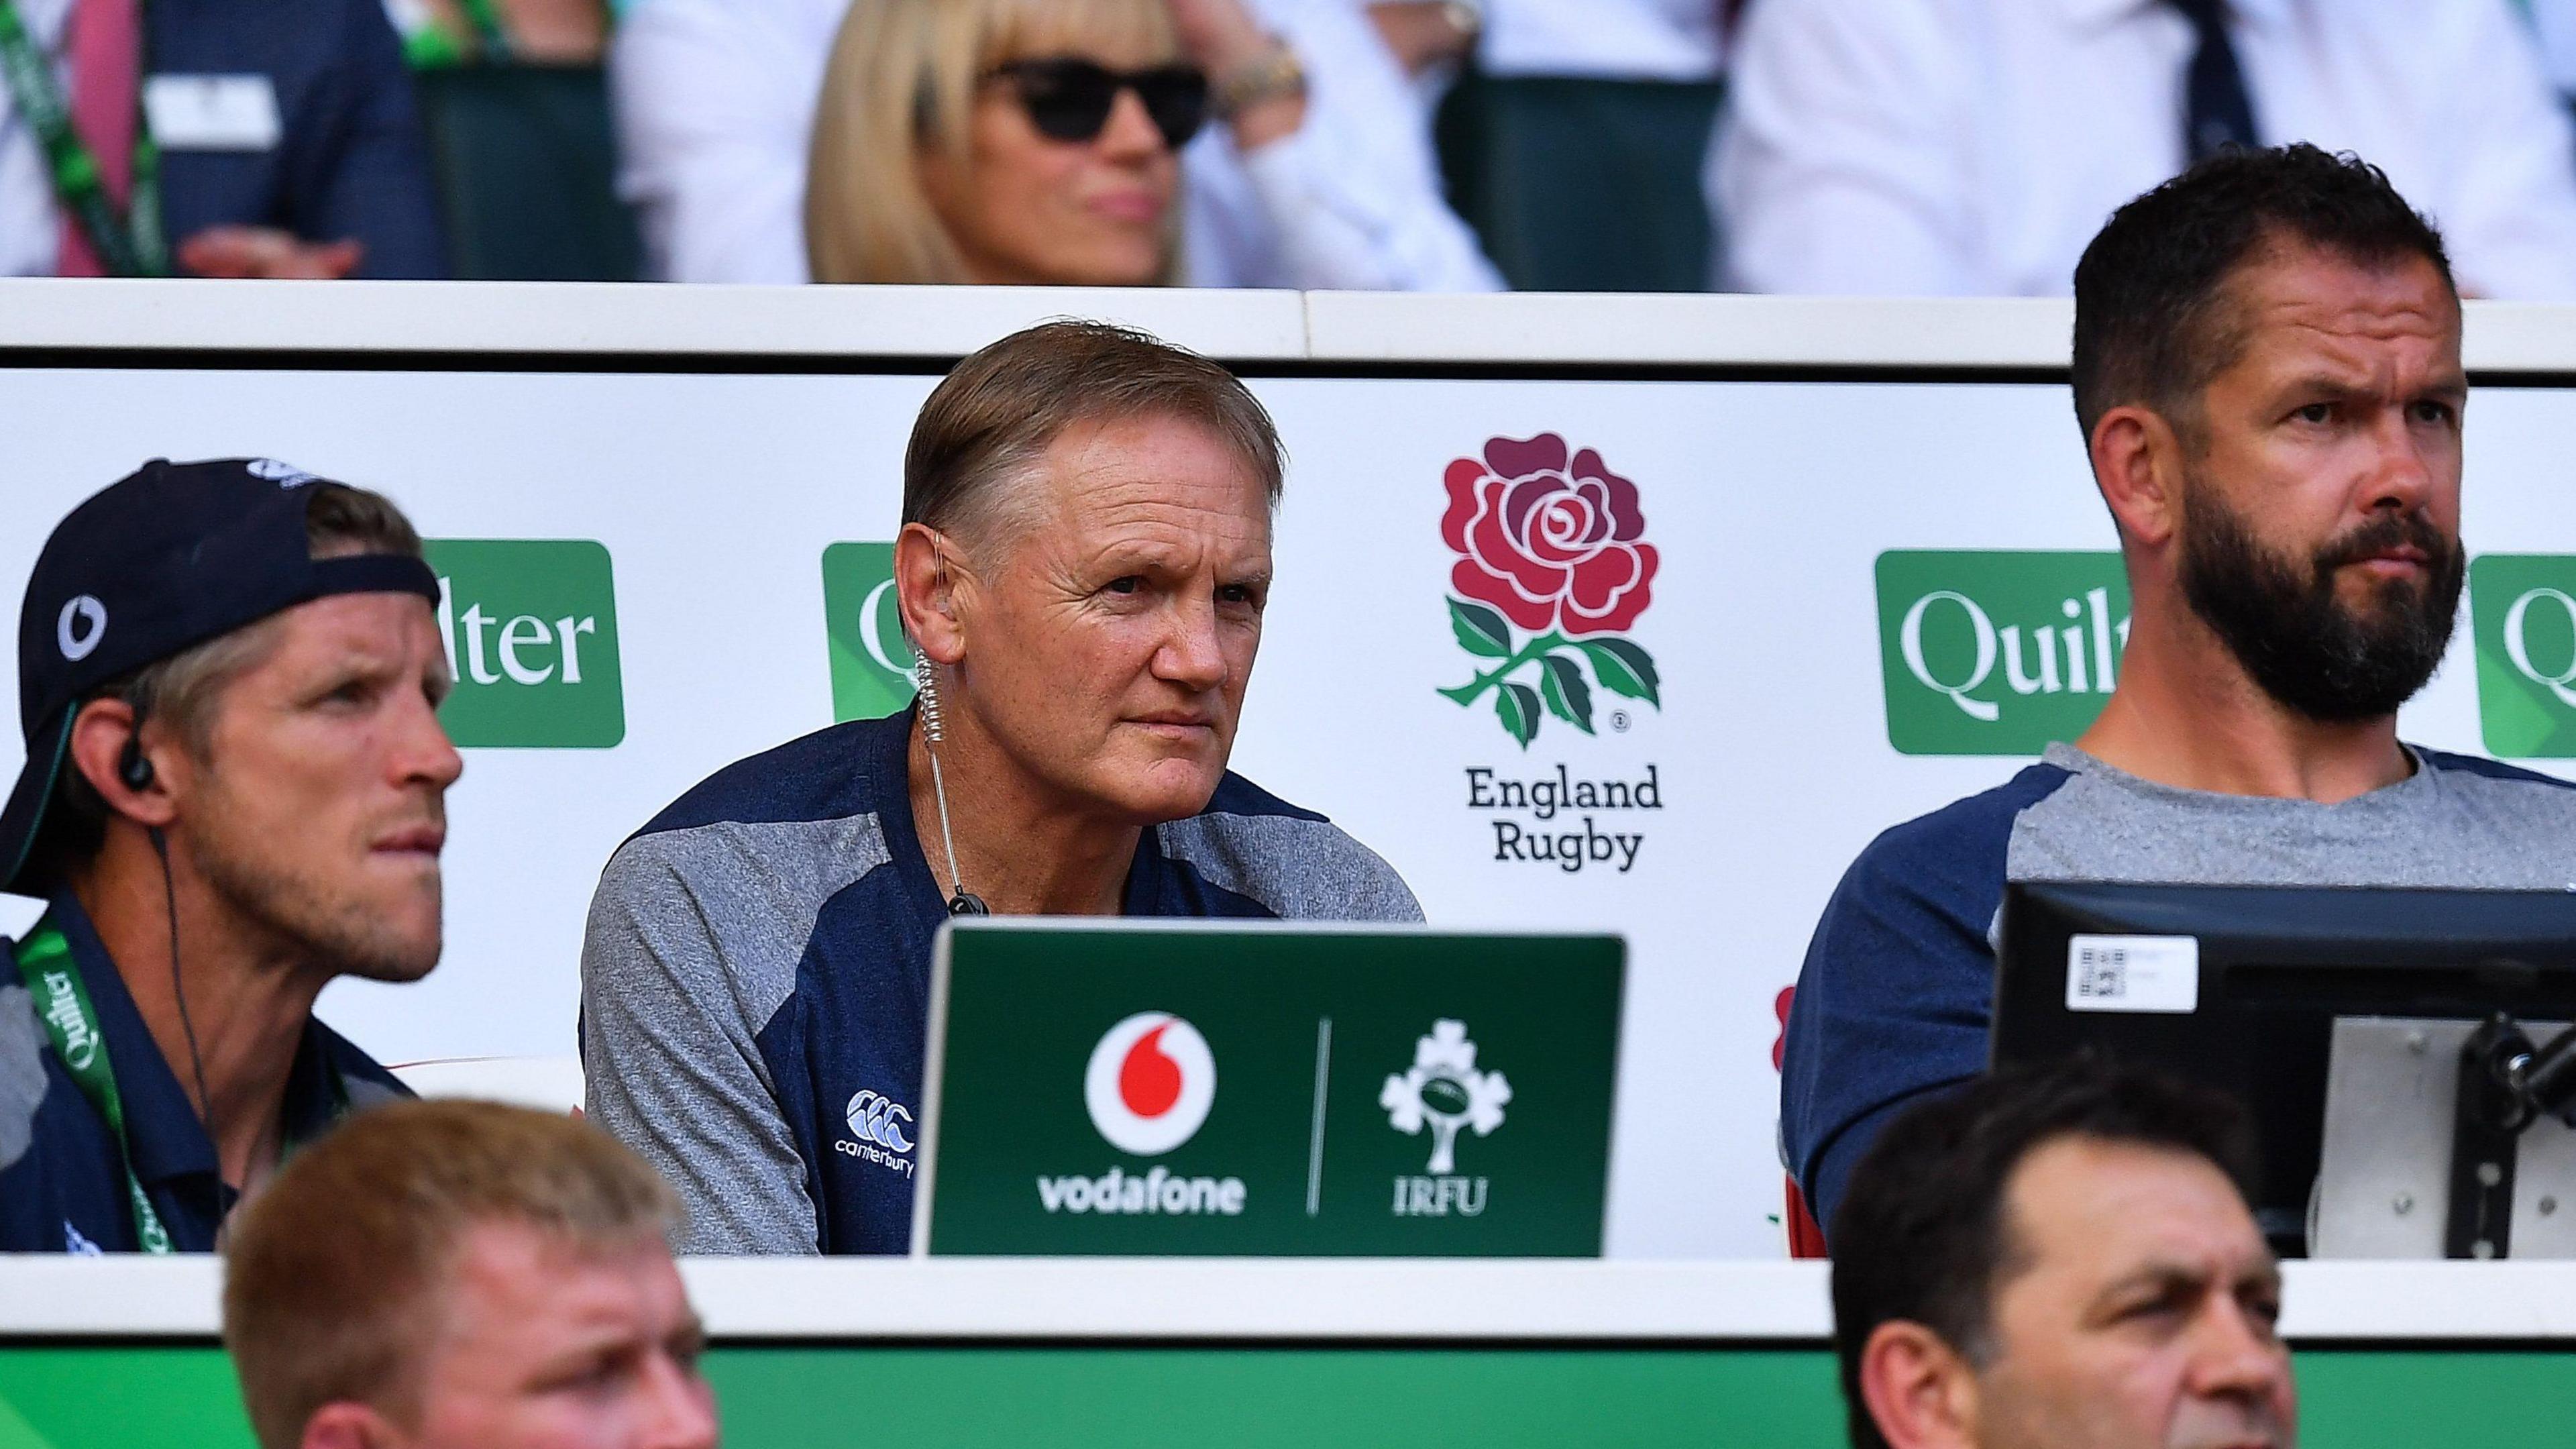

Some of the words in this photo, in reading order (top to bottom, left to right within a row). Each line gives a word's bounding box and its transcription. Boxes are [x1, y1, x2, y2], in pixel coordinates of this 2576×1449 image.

[1464, 764, 1663, 820] England
[1492, 817, 1644, 872] Rugby
[44, 971, 99, 1071] Quilter
[835, 1139, 914, 1179] canterbury
[1037, 1165, 1246, 1216] vodafone
[1393, 1176, 1489, 1216] IRFU
